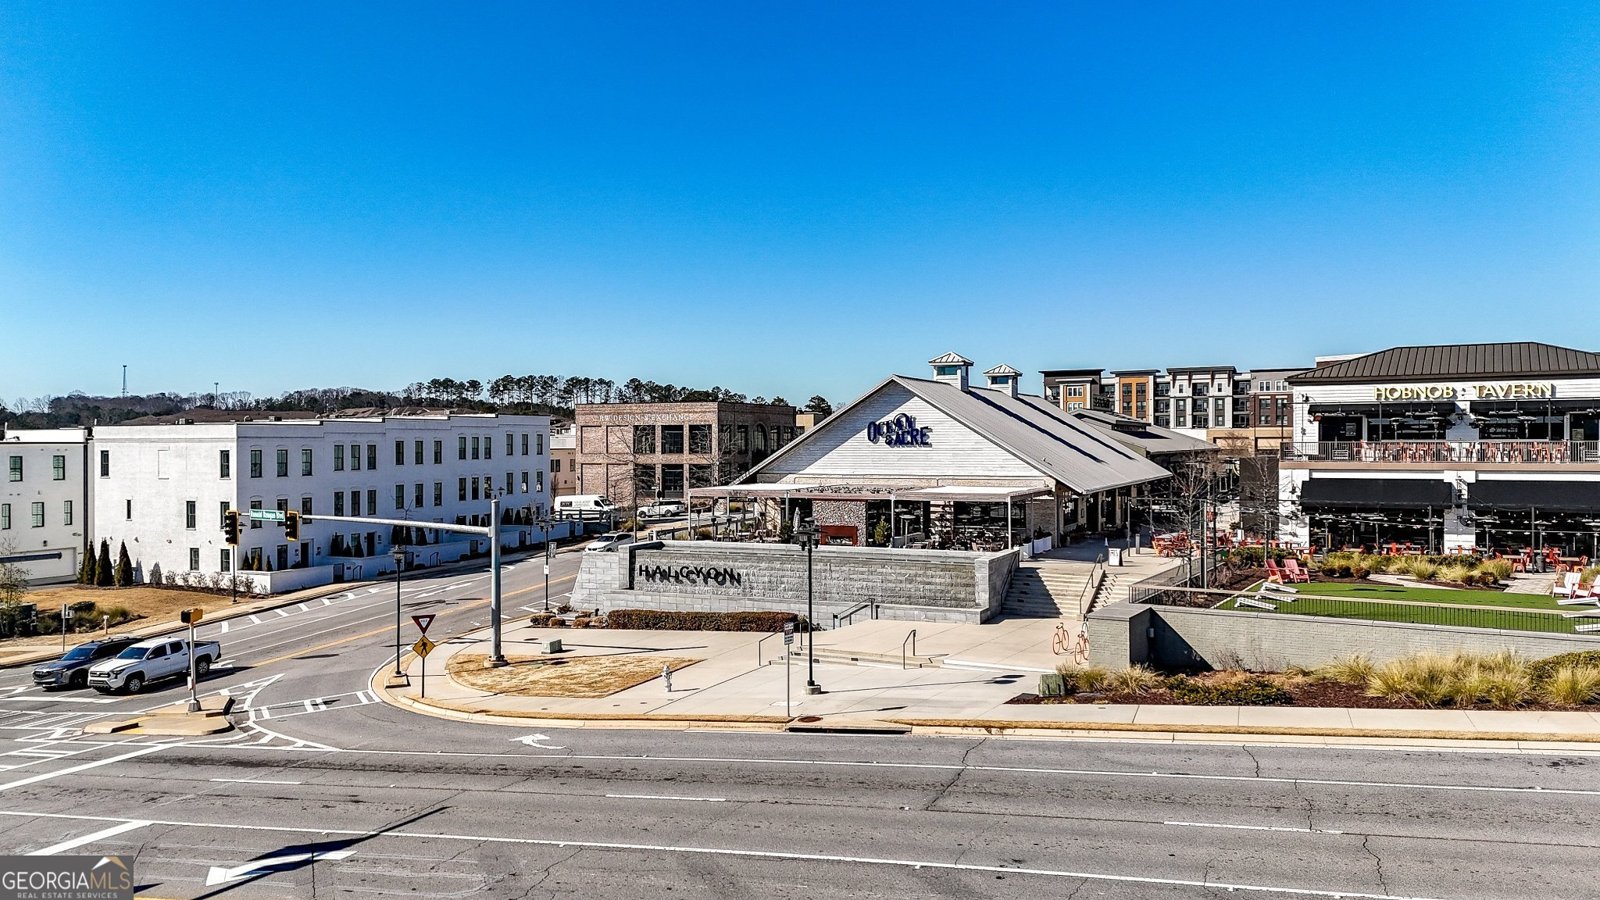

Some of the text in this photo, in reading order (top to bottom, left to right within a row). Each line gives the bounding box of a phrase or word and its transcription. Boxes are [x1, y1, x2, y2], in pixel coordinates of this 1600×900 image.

[1374, 382, 1552, 400] HOBNOB TAVERN
[639, 565, 734, 580] HALCYON
